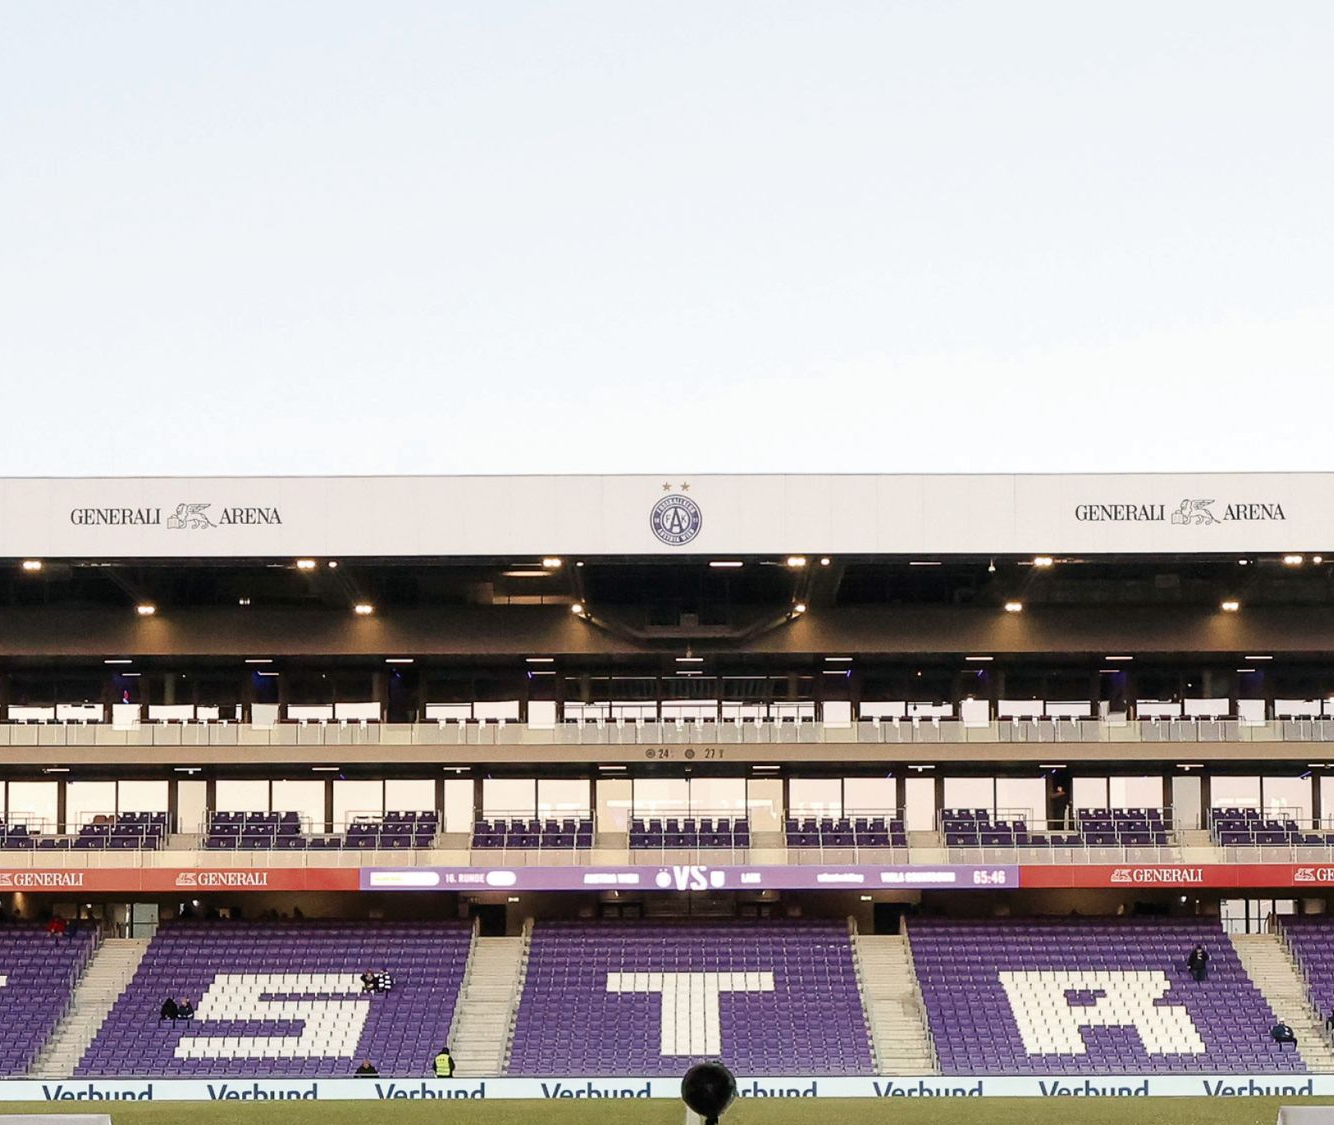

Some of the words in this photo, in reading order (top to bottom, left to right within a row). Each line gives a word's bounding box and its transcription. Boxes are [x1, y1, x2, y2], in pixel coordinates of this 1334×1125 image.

[71, 508, 161, 525] GENERALI
[219, 507, 283, 525] ARENA
[1075, 504, 1165, 522] GENERALI
[1223, 503, 1286, 521] ARENA
[13, 873, 84, 887] GENERALI
[197, 872, 268, 886] GENERALI
[673, 866, 708, 891] VS
[972, 870, 1006, 884] 65:46
[1132, 868, 1203, 882] GENERALI
[42, 1084, 152, 1099] Verbund
[207, 1083, 317, 1099] Verbund
[375, 1082, 485, 1098] Verbund
[541, 1082, 651, 1098] Verbund
[873, 1081, 983, 1097] Verbund
[1038, 1080, 1148, 1096] Verbund
[1203, 1079, 1312, 1095] Verbund
